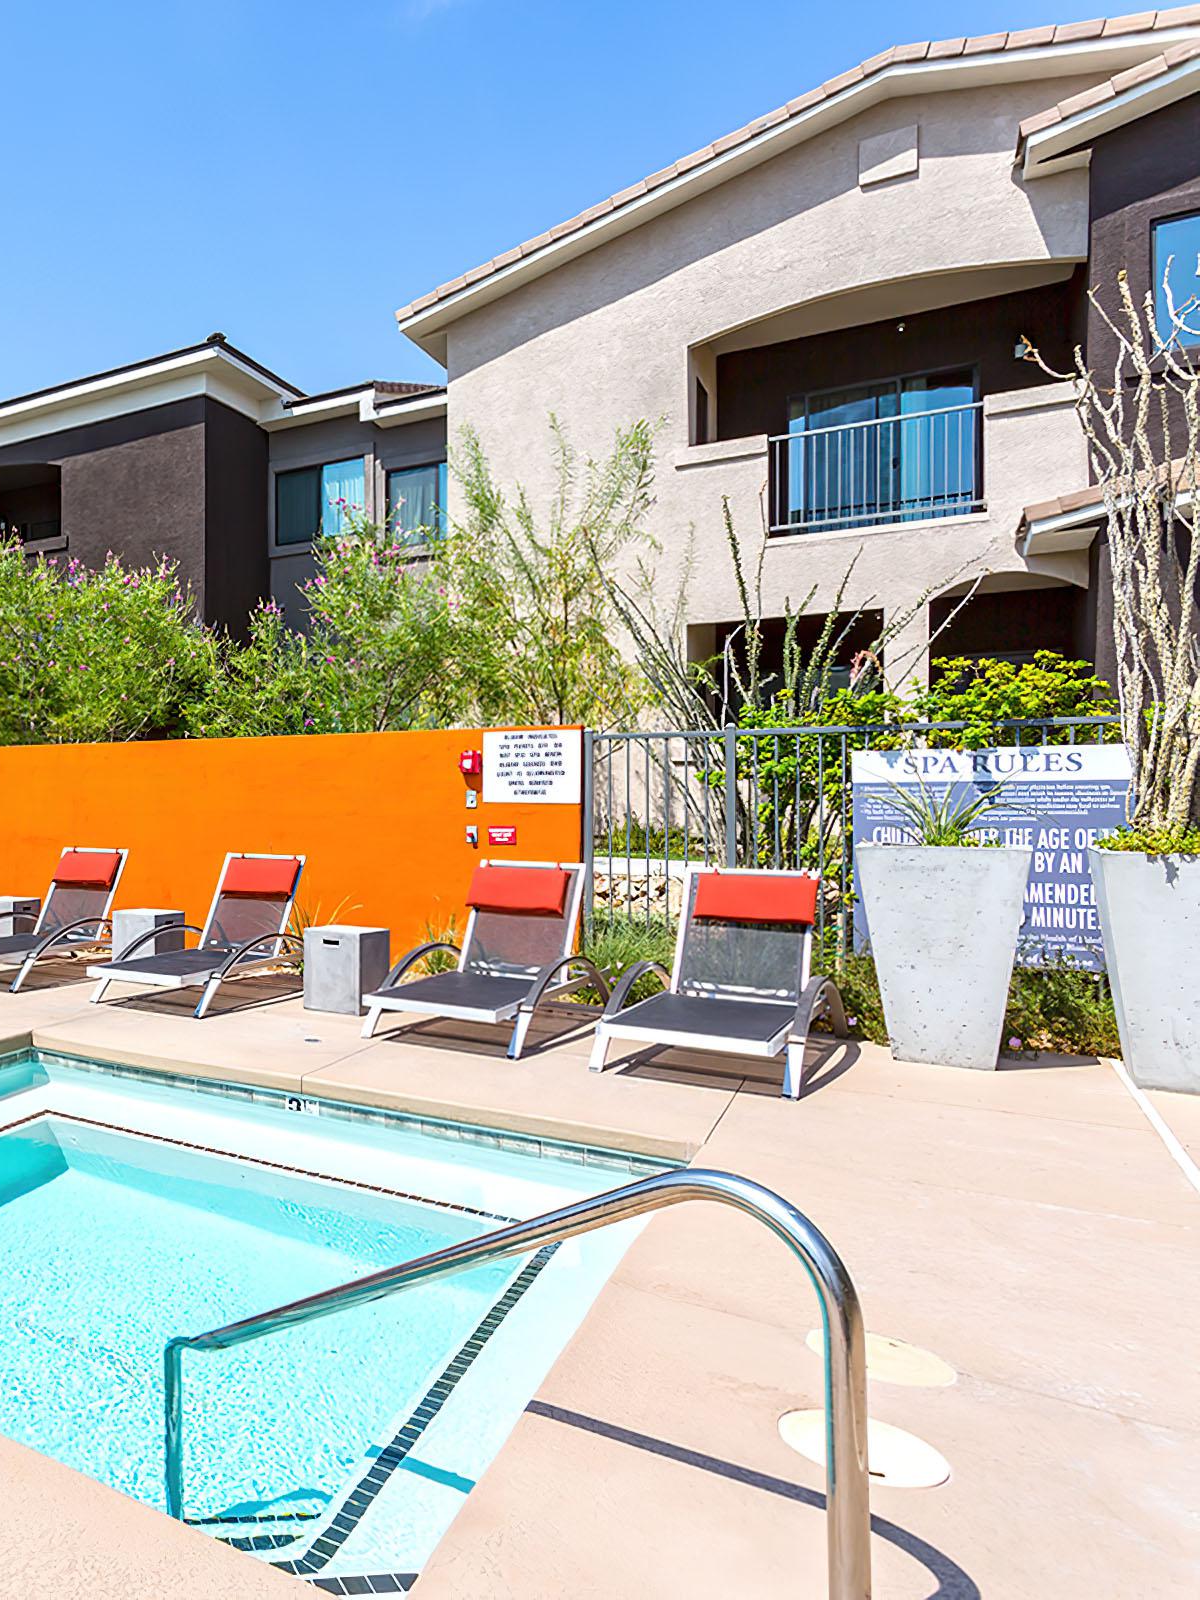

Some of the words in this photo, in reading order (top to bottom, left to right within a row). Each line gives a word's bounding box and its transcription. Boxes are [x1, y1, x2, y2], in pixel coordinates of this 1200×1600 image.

[903, 755, 959, 775] SPA
[972, 752, 1083, 773] RULES
[1004, 828, 1033, 848] THE
[1037, 828, 1070, 850] AGE
[1034, 851, 1056, 873] BY
[1059, 852, 1083, 874] AN
[1031, 906, 1102, 930] MINUTE
